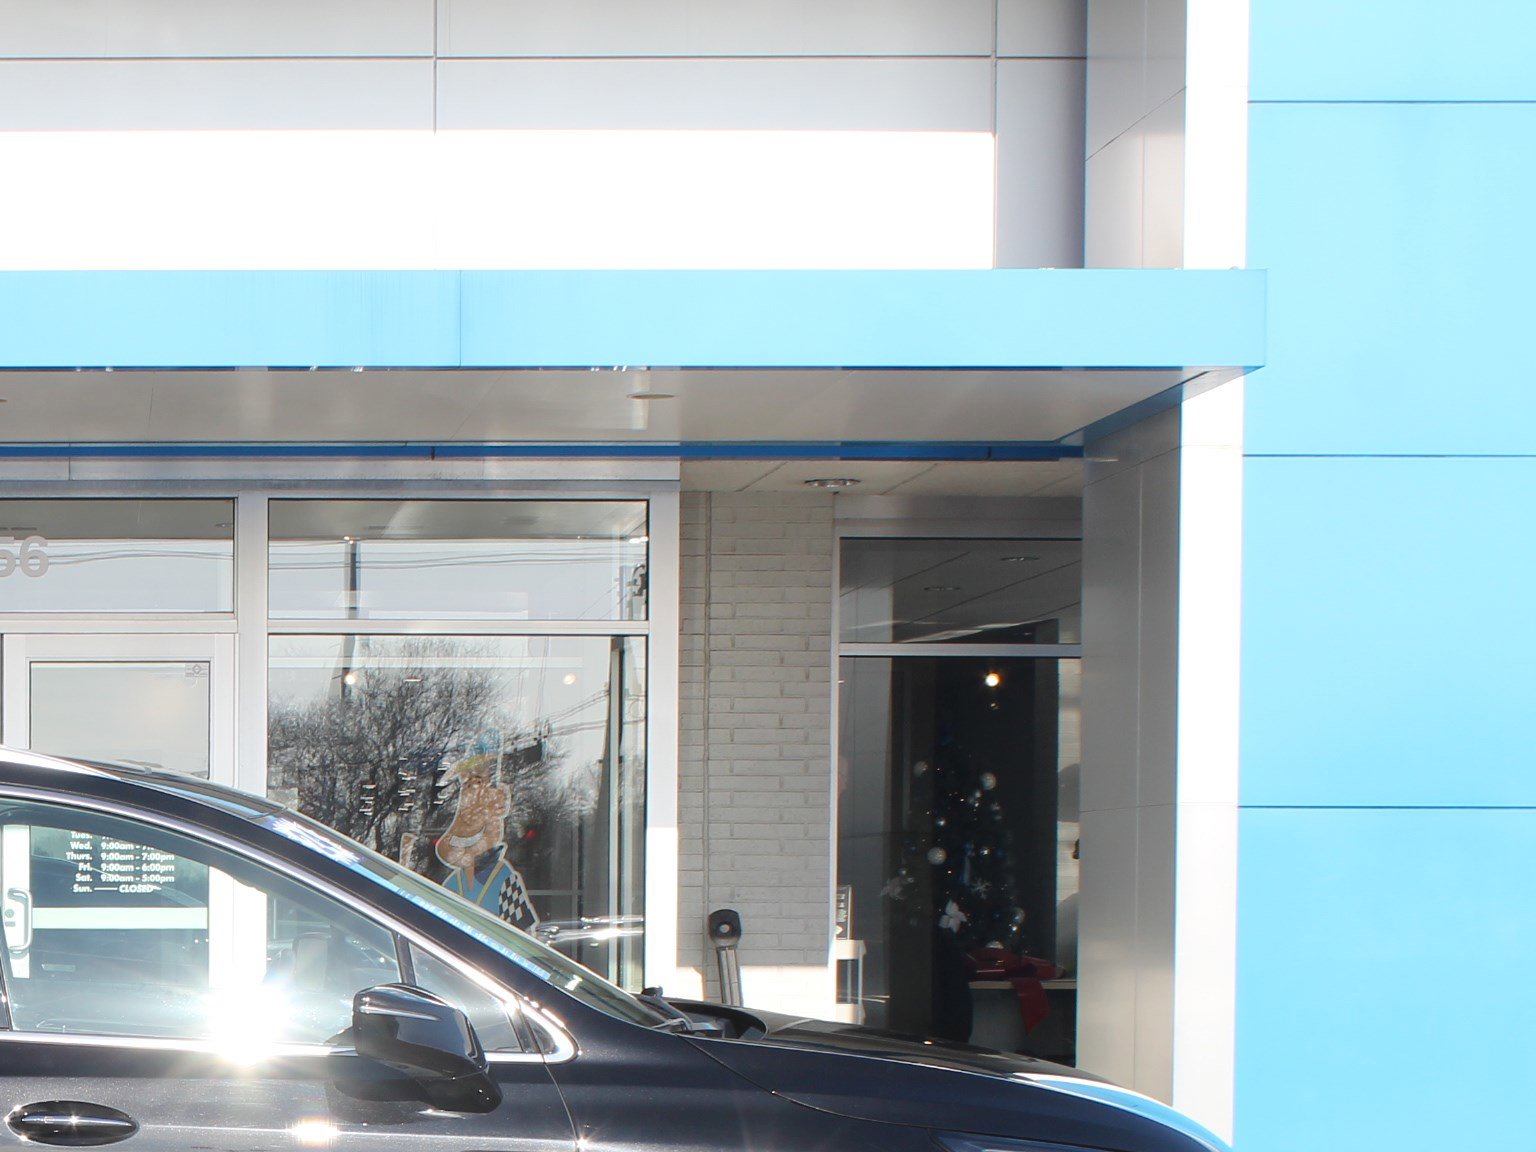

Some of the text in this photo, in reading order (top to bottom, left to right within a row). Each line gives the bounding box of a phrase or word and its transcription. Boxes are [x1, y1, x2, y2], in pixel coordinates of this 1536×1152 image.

[71, 831, 93, 839] Tues.
[69, 841, 93, 850] Wed.
[100, 841, 135, 851] 9:00am
[65, 851, 93, 860] Thurs.
[100, 852, 135, 861] 9:00am
[141, 852, 175, 863] 7:00pm
[78, 862, 93, 871] Fri.
[100, 863, 135, 872] 9:00am
[141, 863, 175, 874] 6:00pm
[75, 873, 93, 882] Sat.
[100, 873, 135, 882] 9:00am
[141, 873, 175, 884] 5:00pm
[72, 884, 154, 893] Sun. CLOSED
